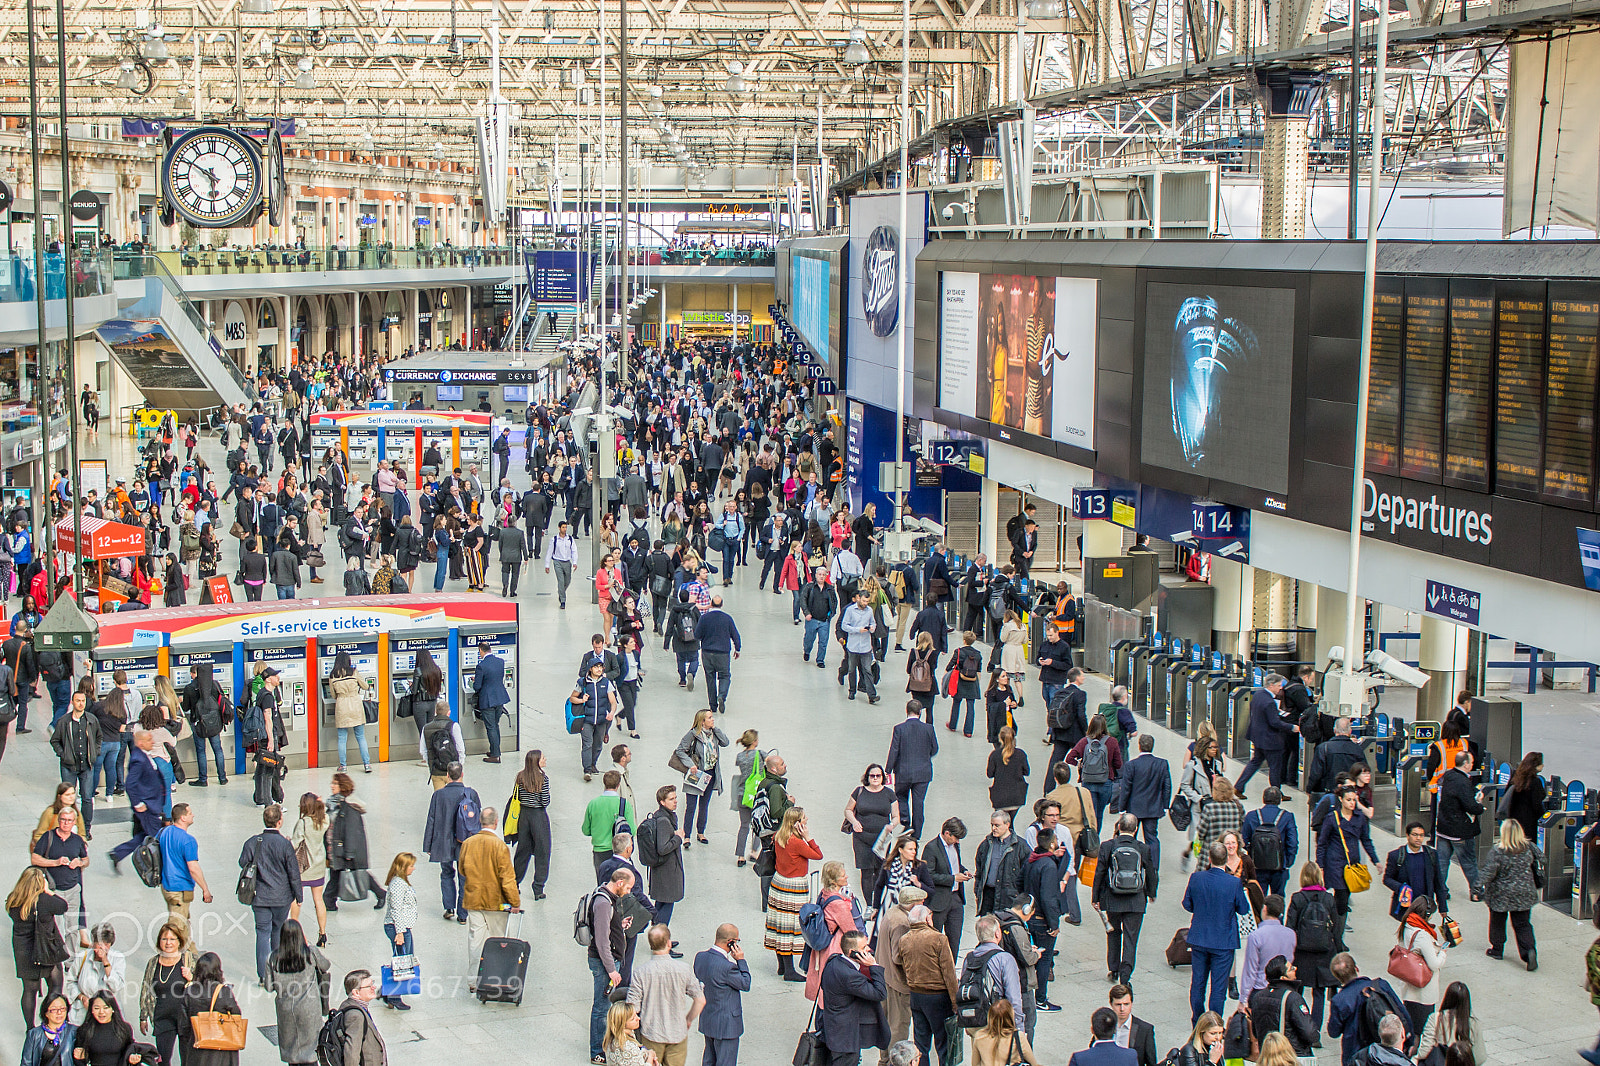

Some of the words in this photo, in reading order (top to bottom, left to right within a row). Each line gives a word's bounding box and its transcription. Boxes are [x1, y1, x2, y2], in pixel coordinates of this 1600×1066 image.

[866, 248, 895, 313] Boots
[1570, 303, 1590, 312] Platform
[225, 322, 244, 340] M&S
[790, 334, 795, 342] 7
[797, 344, 803, 352] 8
[804, 354, 810, 363] 9
[396, 372, 439, 380] CURRENCY
[453, 372, 496, 380] EXCHANGE
[810, 366, 822, 377] 10
[821, 381, 830, 392] 11
[937, 445, 954, 460] 12
[1522, 466, 1536, 476] Trains
[1573, 474, 1587, 484] Trains
[1073, 494, 1080, 513] 13
[1084, 495, 1106, 514] 13
[1265, 497, 1286, 510] JCDecaux
[1361, 478, 1493, 545] Departures
[1192, 510, 1204, 532] 14
[1208, 511, 1233, 532] 14
[98, 536, 111, 547] 12
[216, 593, 228, 604] £12
[1450, 606, 1460, 616] Wide
[1460, 610, 1468, 619] gate
[241, 617, 327, 635] Self-service
[333, 616, 381, 630] tickets
